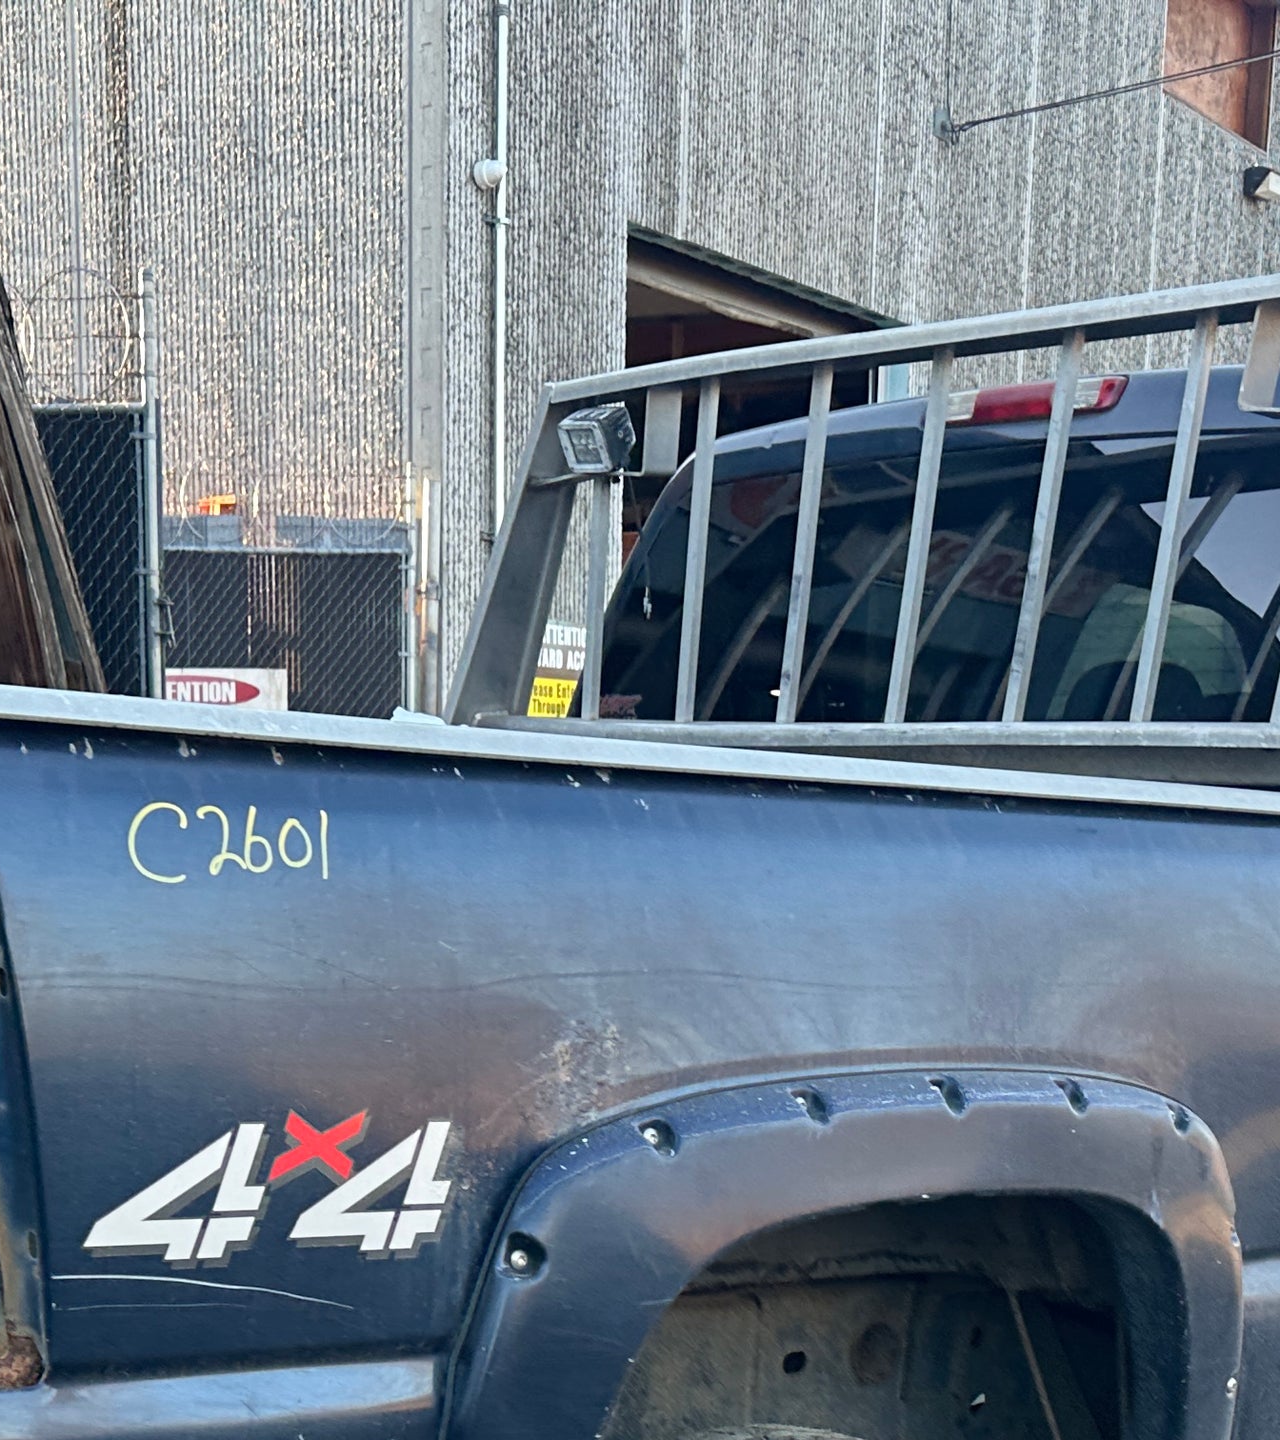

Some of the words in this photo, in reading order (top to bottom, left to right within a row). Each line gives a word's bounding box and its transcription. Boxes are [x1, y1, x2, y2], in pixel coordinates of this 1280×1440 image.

[543, 623, 587, 649] ATTENTIO
[165, 680, 237, 703] ENTION
[533, 684, 554, 699] ease
[532, 698, 566, 718] Through
[127, 801, 329, 884] C2601
